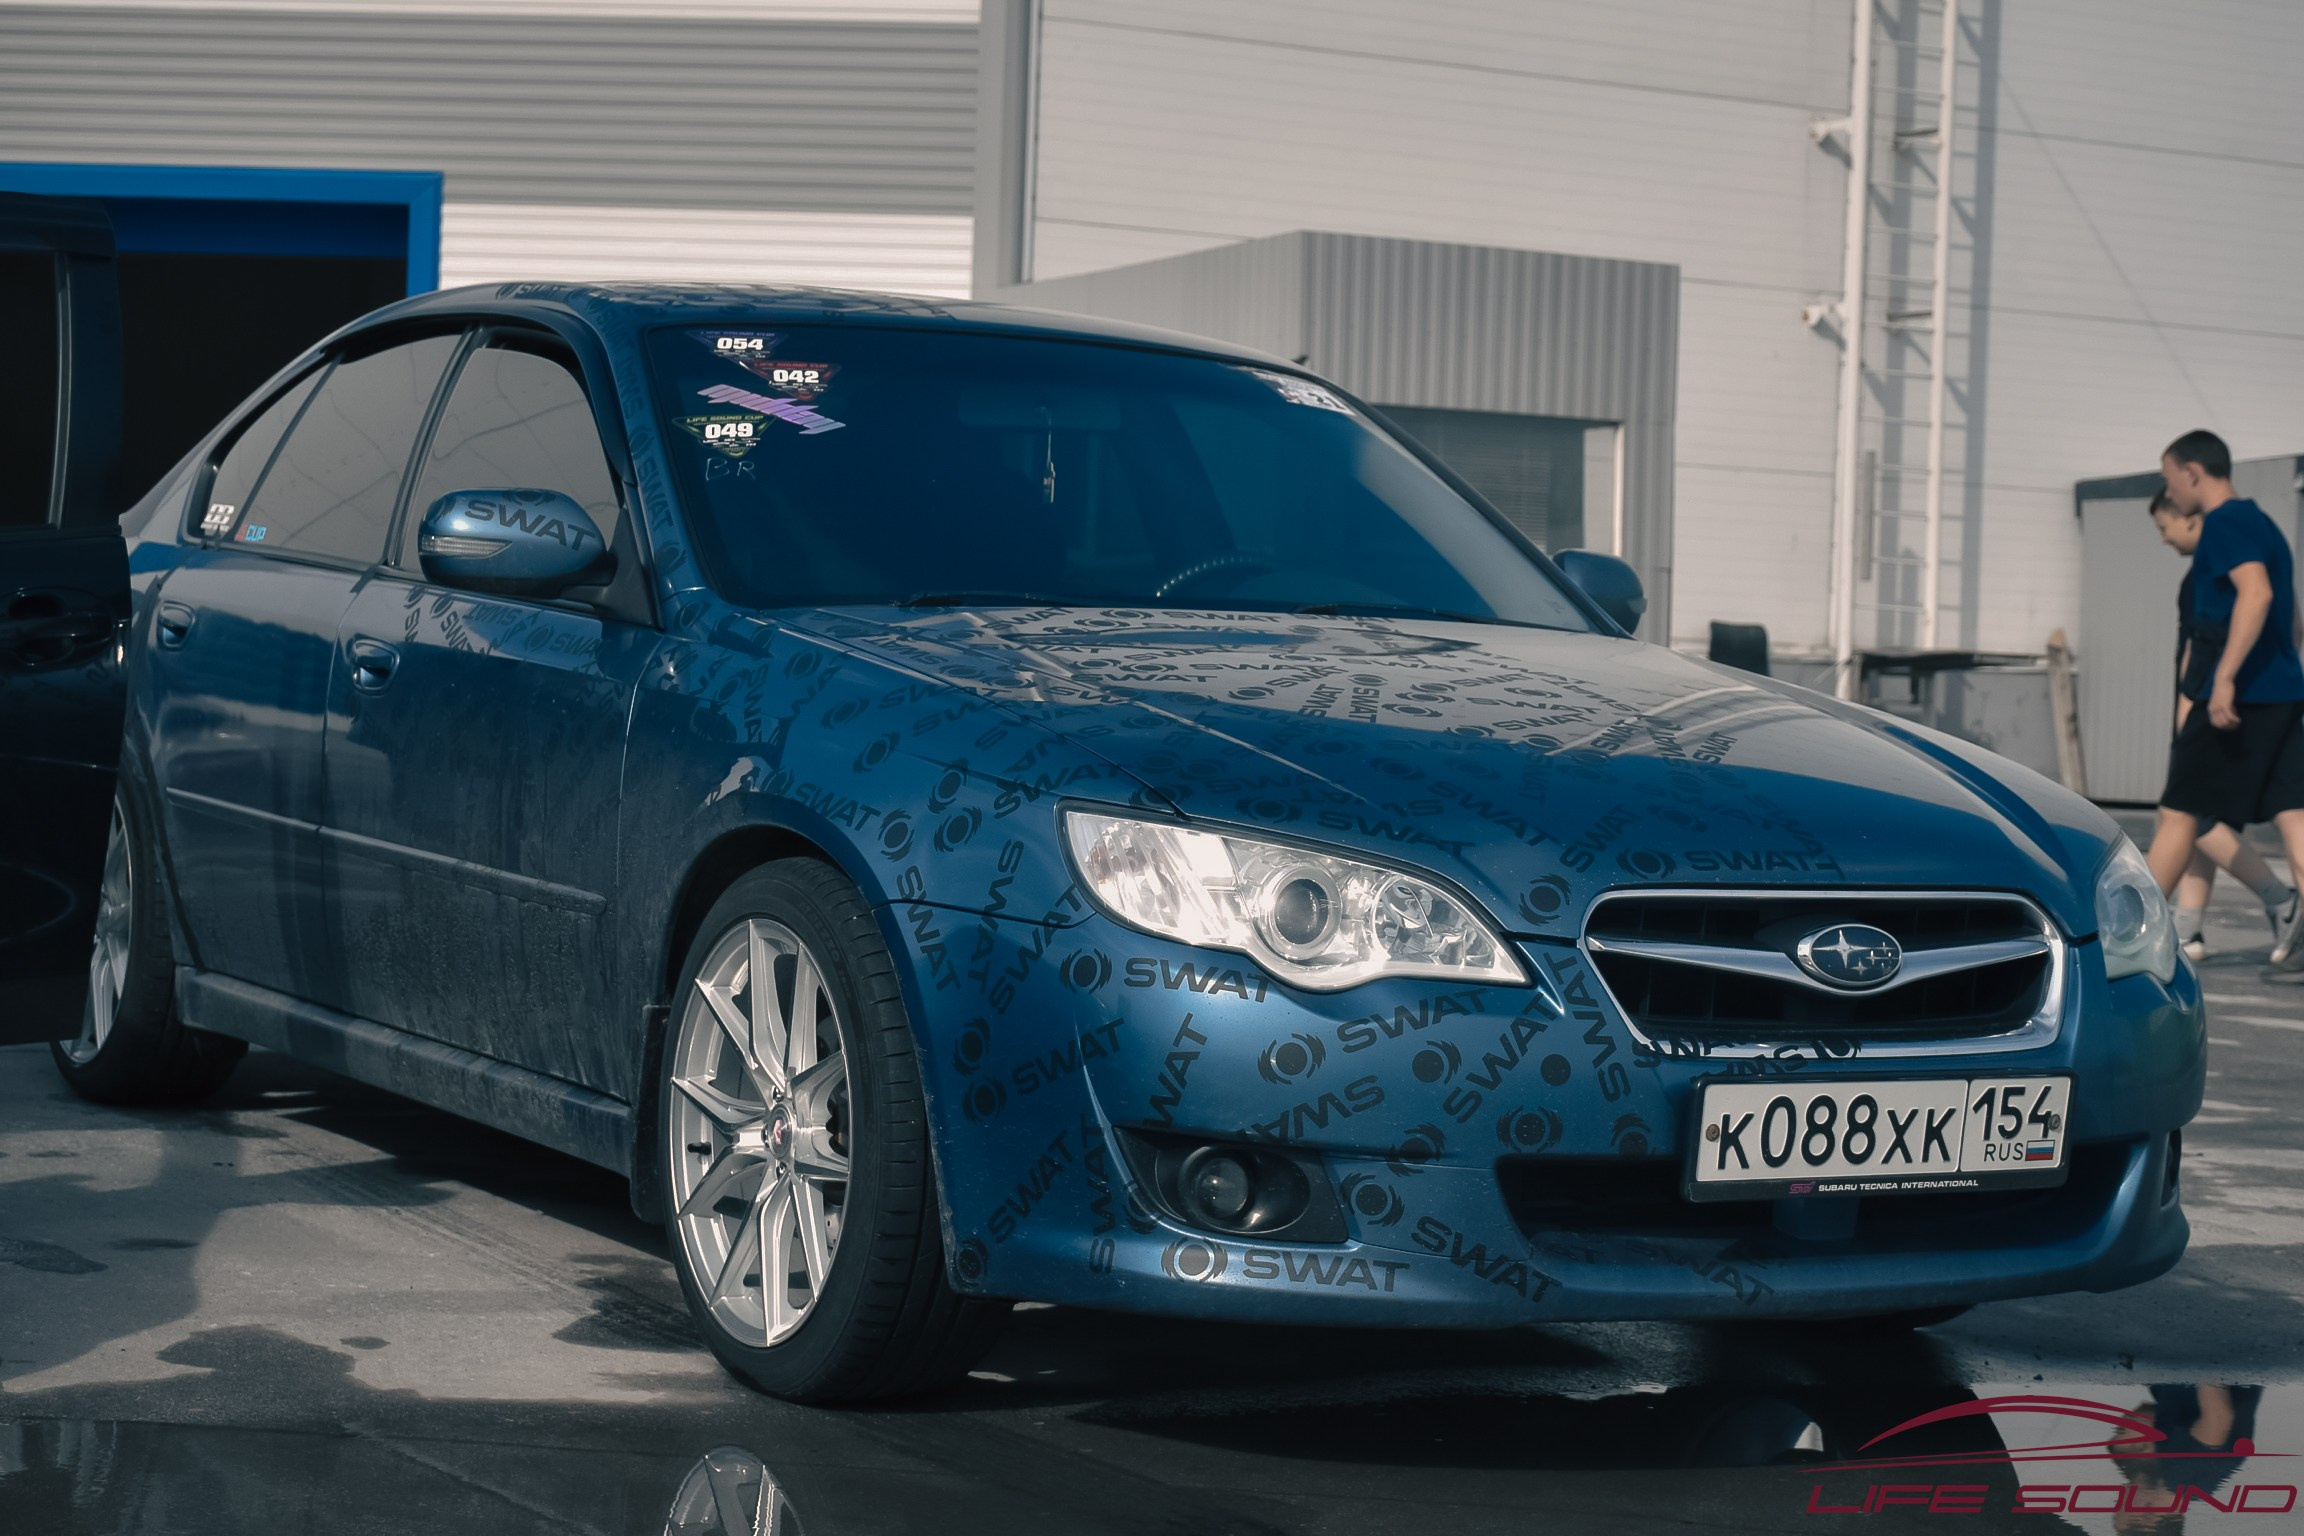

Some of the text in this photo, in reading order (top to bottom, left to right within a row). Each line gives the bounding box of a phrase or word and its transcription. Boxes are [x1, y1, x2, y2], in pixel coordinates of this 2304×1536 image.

[717, 337, 763, 350] 054
[773, 369, 819, 383] 042
[705, 422, 753, 439] 049
[463, 500, 596, 552] SWAT
[1071, 673, 1218, 683] SWAT
[1300, 683, 1346, 719] SWAT
[1348, 687, 1381, 723] SWAT
[1492, 712, 1595, 731] SWAT
[1692, 731, 1739, 764] SWAT
[794, 782, 881, 832] SWAT
[1427, 780, 1562, 847] SWAT
[1317, 810, 1476, 857] SWAT
[1560, 803, 1640, 873] SWAT
[1685, 850, 1812, 872] SWAT
[897, 865, 961, 991] SWAT
[968, 838, 1025, 995] SWAT
[989, 883, 1082, 1015] SWAT
[1123, 957, 1270, 1003] SWAT
[1336, 987, 1491, 1053] SWAT
[1544, 951, 1632, 1102] SWAT
[1012, 1018, 1125, 1095] SWAT
[1443, 992, 1559, 1124] SWAT
[1972, 1085, 2054, 1141] 154
[1983, 1142, 2024, 1162] RUS
[988, 1128, 1076, 1244] SWAT
[1080, 1112, 1116, 1274] SWAT
[1818, 1183, 1857, 1192] SUBARU
[1860, 1182, 1898, 1191] TECNICA
[1901, 1180, 1979, 1189] INTERNATIONAL
[1242, 1247, 1410, 1293] SWAT
[1411, 1215, 1563, 1304] SWAT
